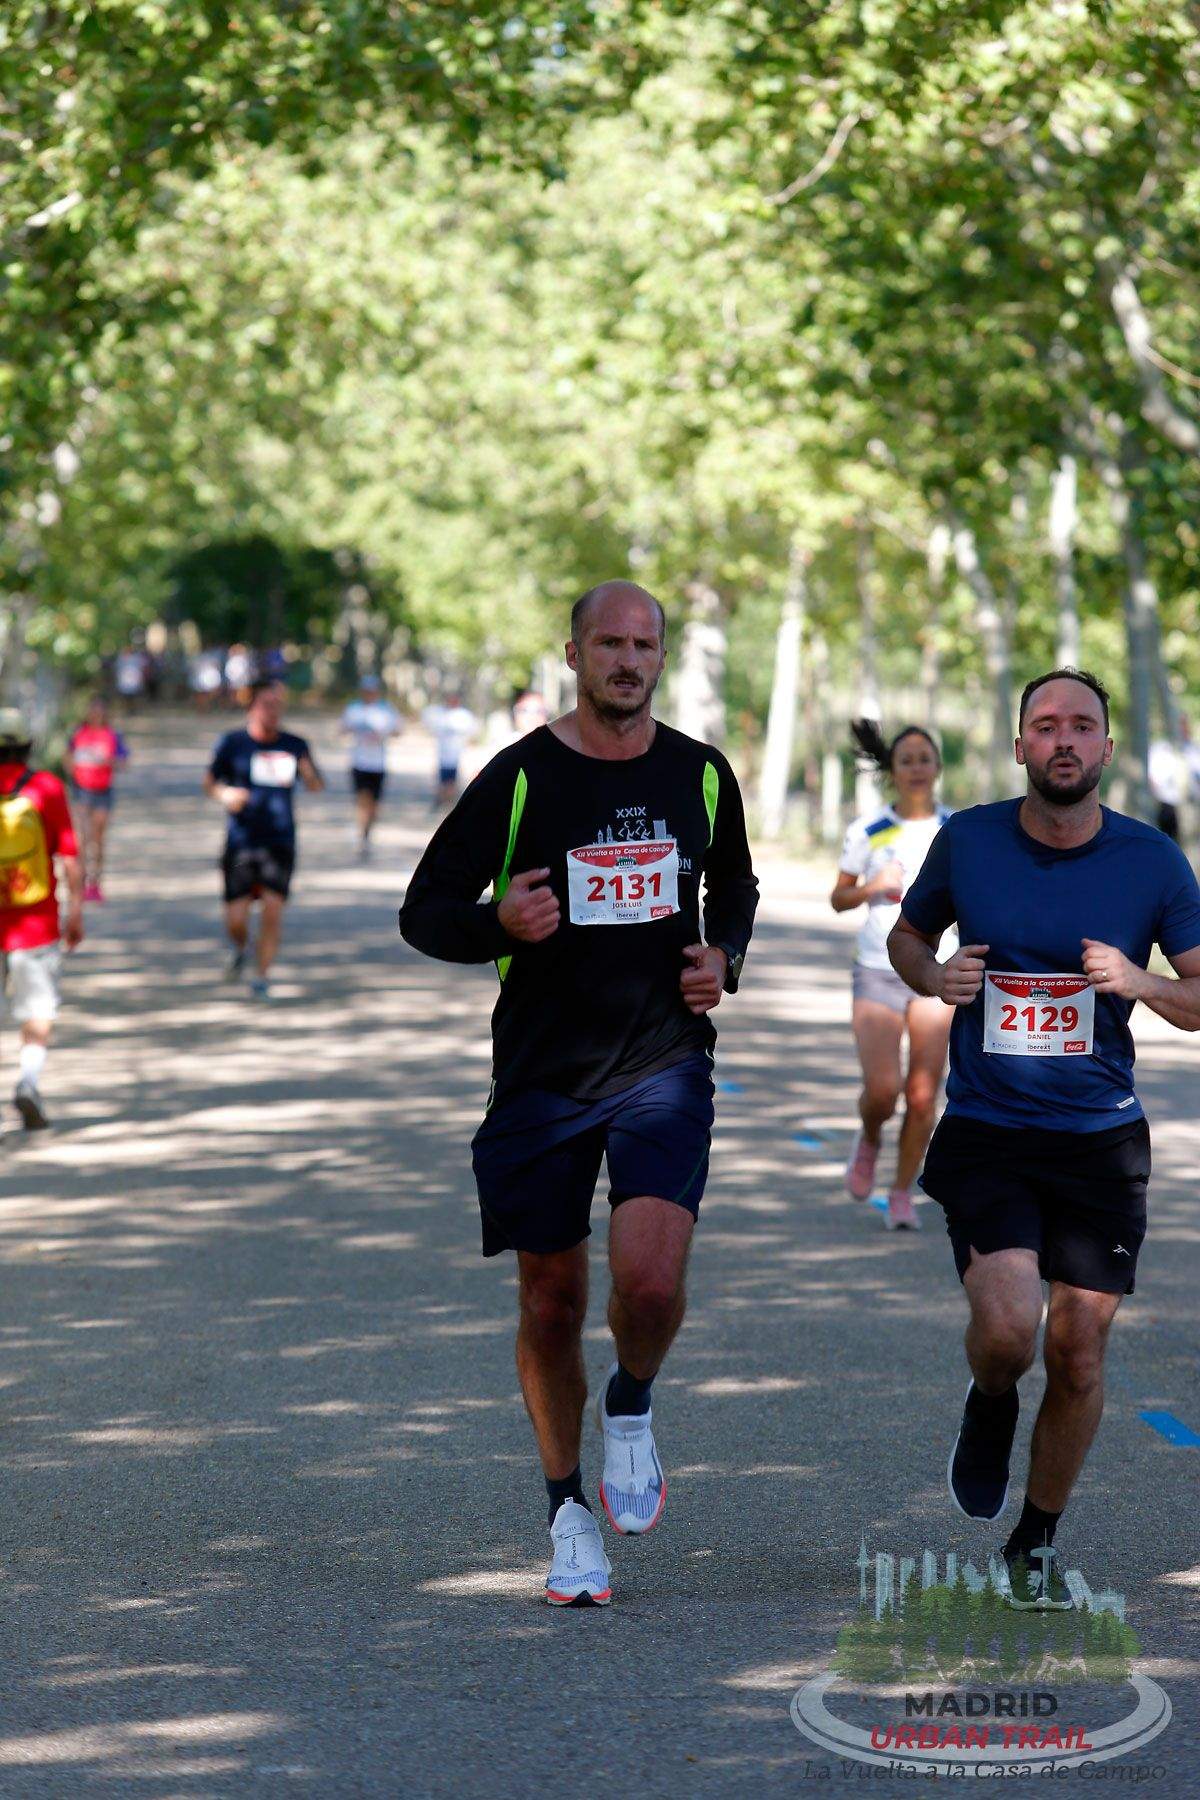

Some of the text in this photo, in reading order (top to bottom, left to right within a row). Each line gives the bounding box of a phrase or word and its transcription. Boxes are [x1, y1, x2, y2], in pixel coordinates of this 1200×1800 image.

[616, 806, 646, 819] XXIX
[586, 849, 608, 857] Vuelta
[623, 847, 640, 855] Casa
[587, 872, 662, 902] 2131
[1065, 979, 1088, 987] Campo
[1000, 1004, 1079, 1032] 2129
